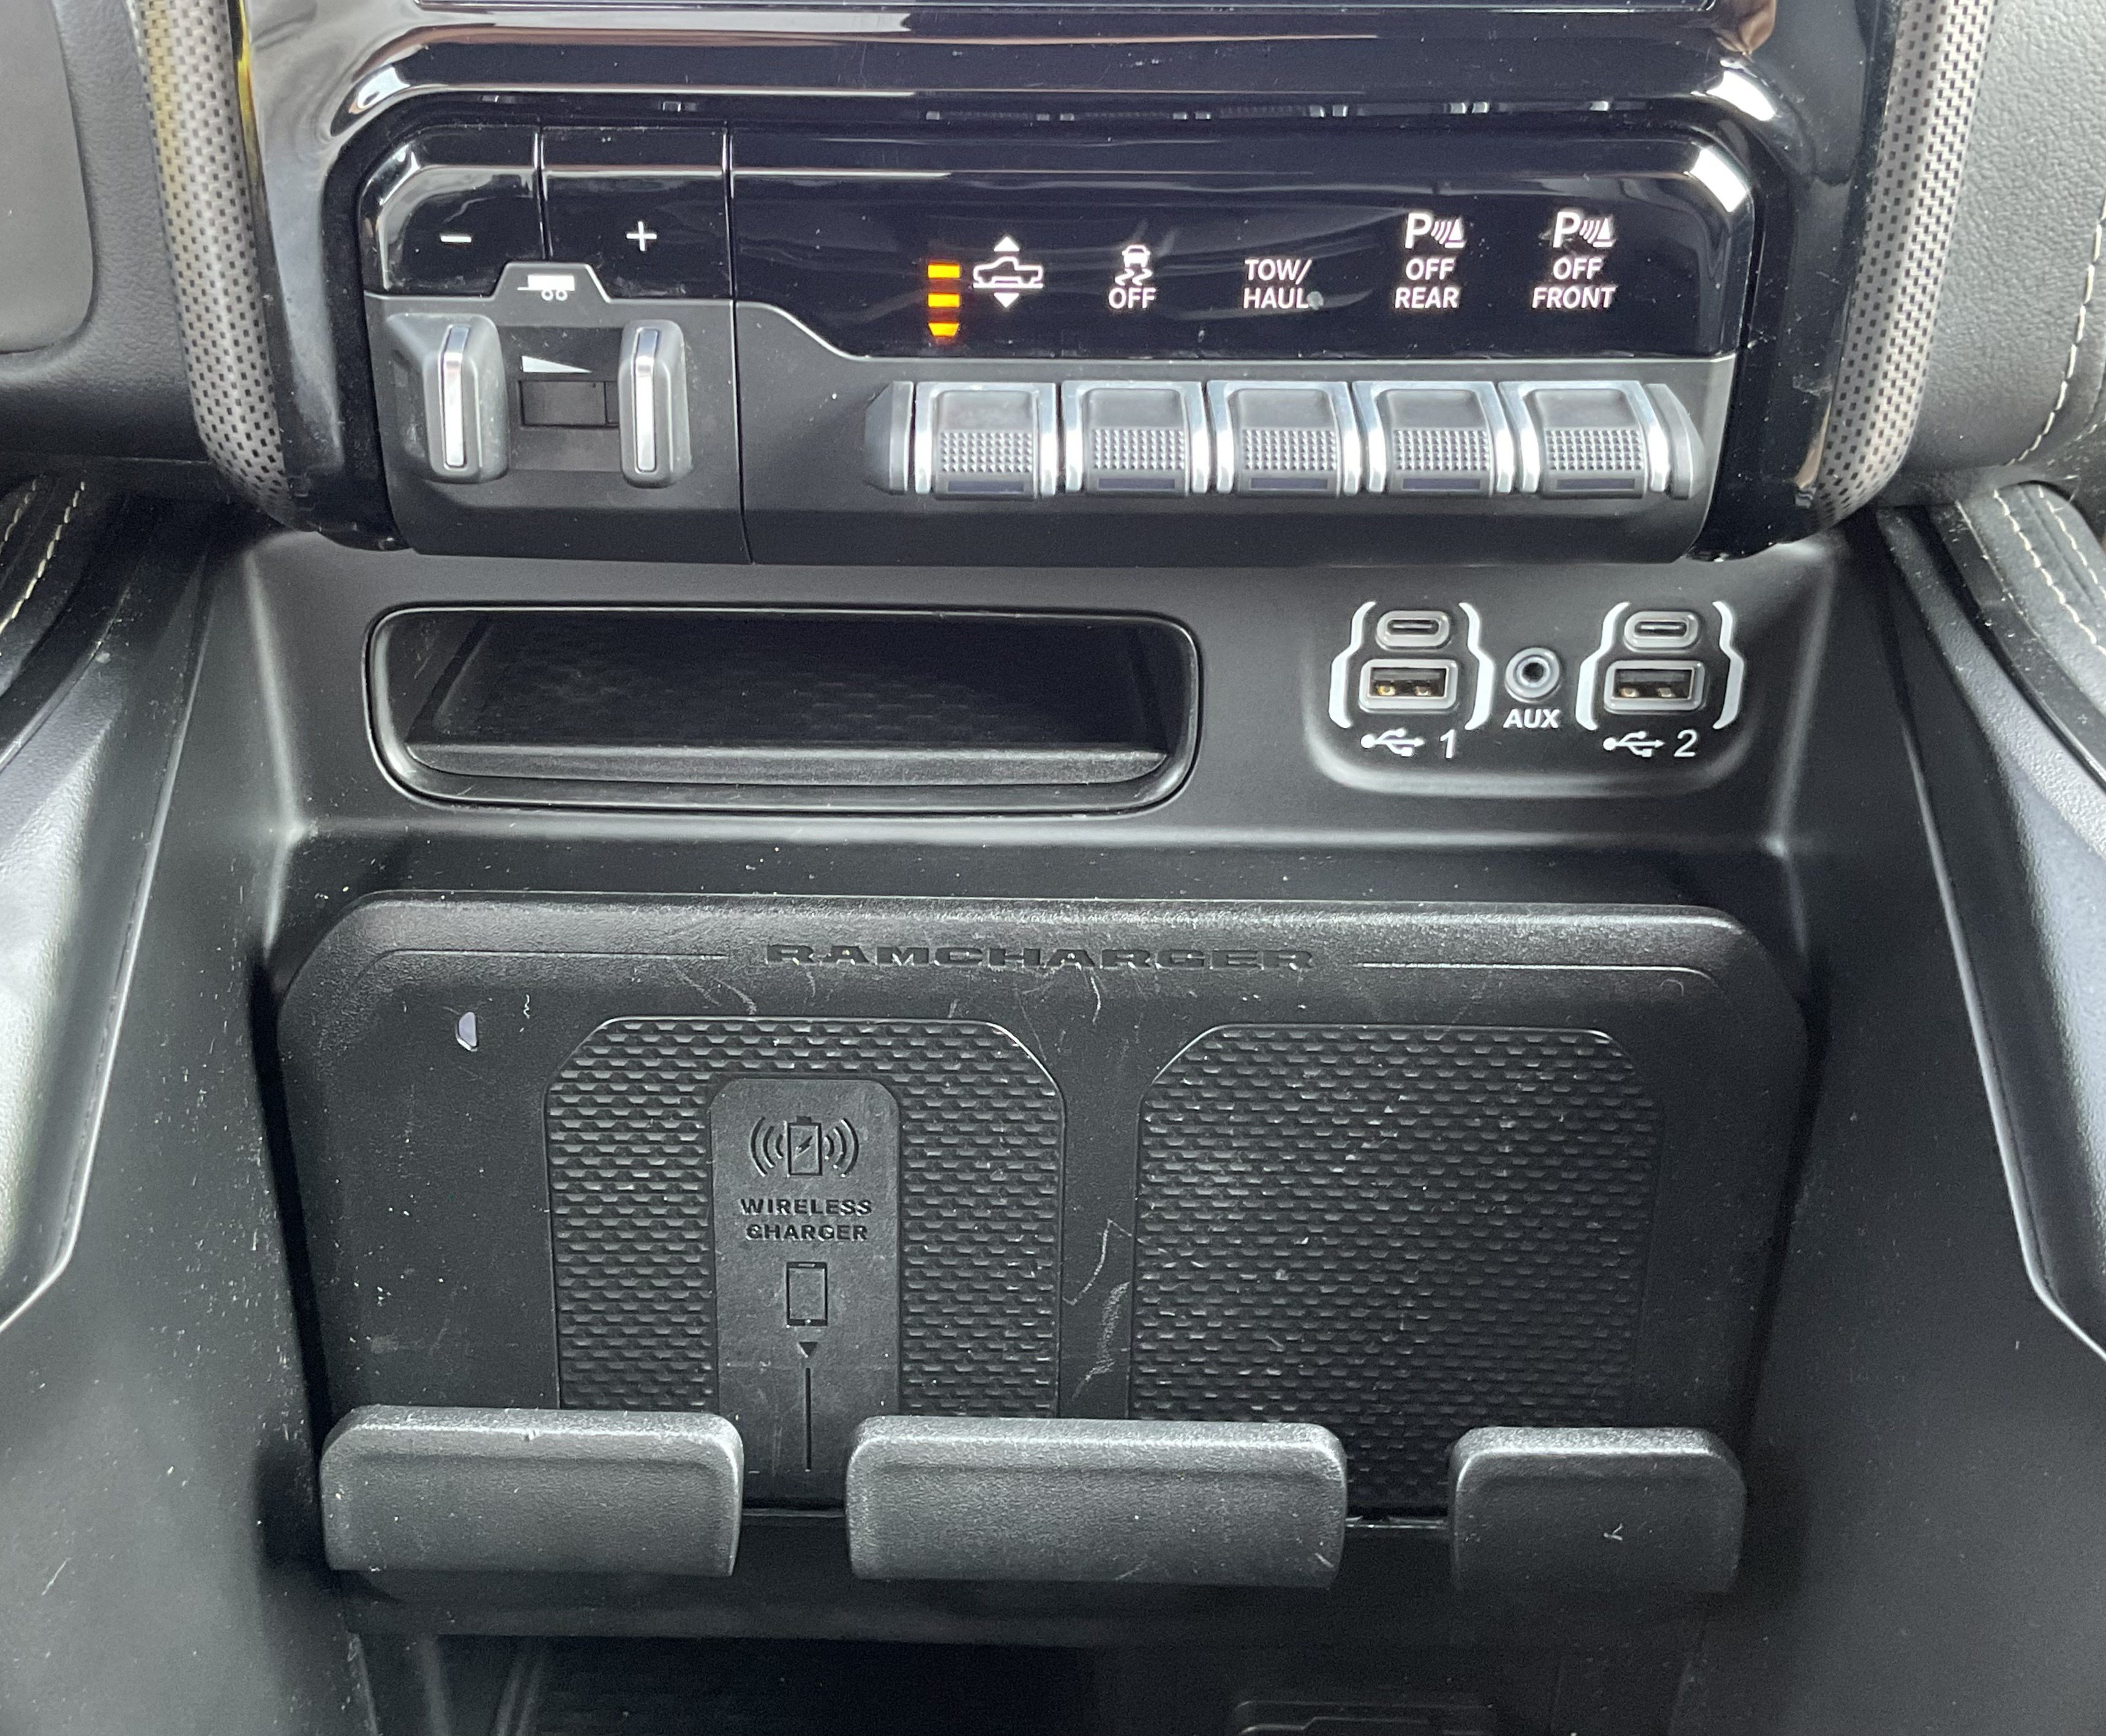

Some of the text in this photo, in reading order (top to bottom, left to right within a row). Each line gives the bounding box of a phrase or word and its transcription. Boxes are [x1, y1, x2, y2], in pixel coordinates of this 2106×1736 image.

[1245, 258, 1313, 284] TOW/
[1406, 258, 1455, 279] OFF
[1553, 256, 1603, 278] OFF
[1109, 287, 1156, 310] OFF
[1243, 286, 1309, 310] HAUL
[1395, 286, 1460, 309] REAR
[1532, 285, 1617, 309] FRONT
[1503, 708, 1561, 729] AUX
[1440, 729, 1457, 759] 1
[1674, 729, 1698, 758] 2
[765, 943, 1314, 971] RAMCHARGER
[738, 1197, 872, 1216] WIRELESS
[745, 1224, 868, 1241] CHARGER
